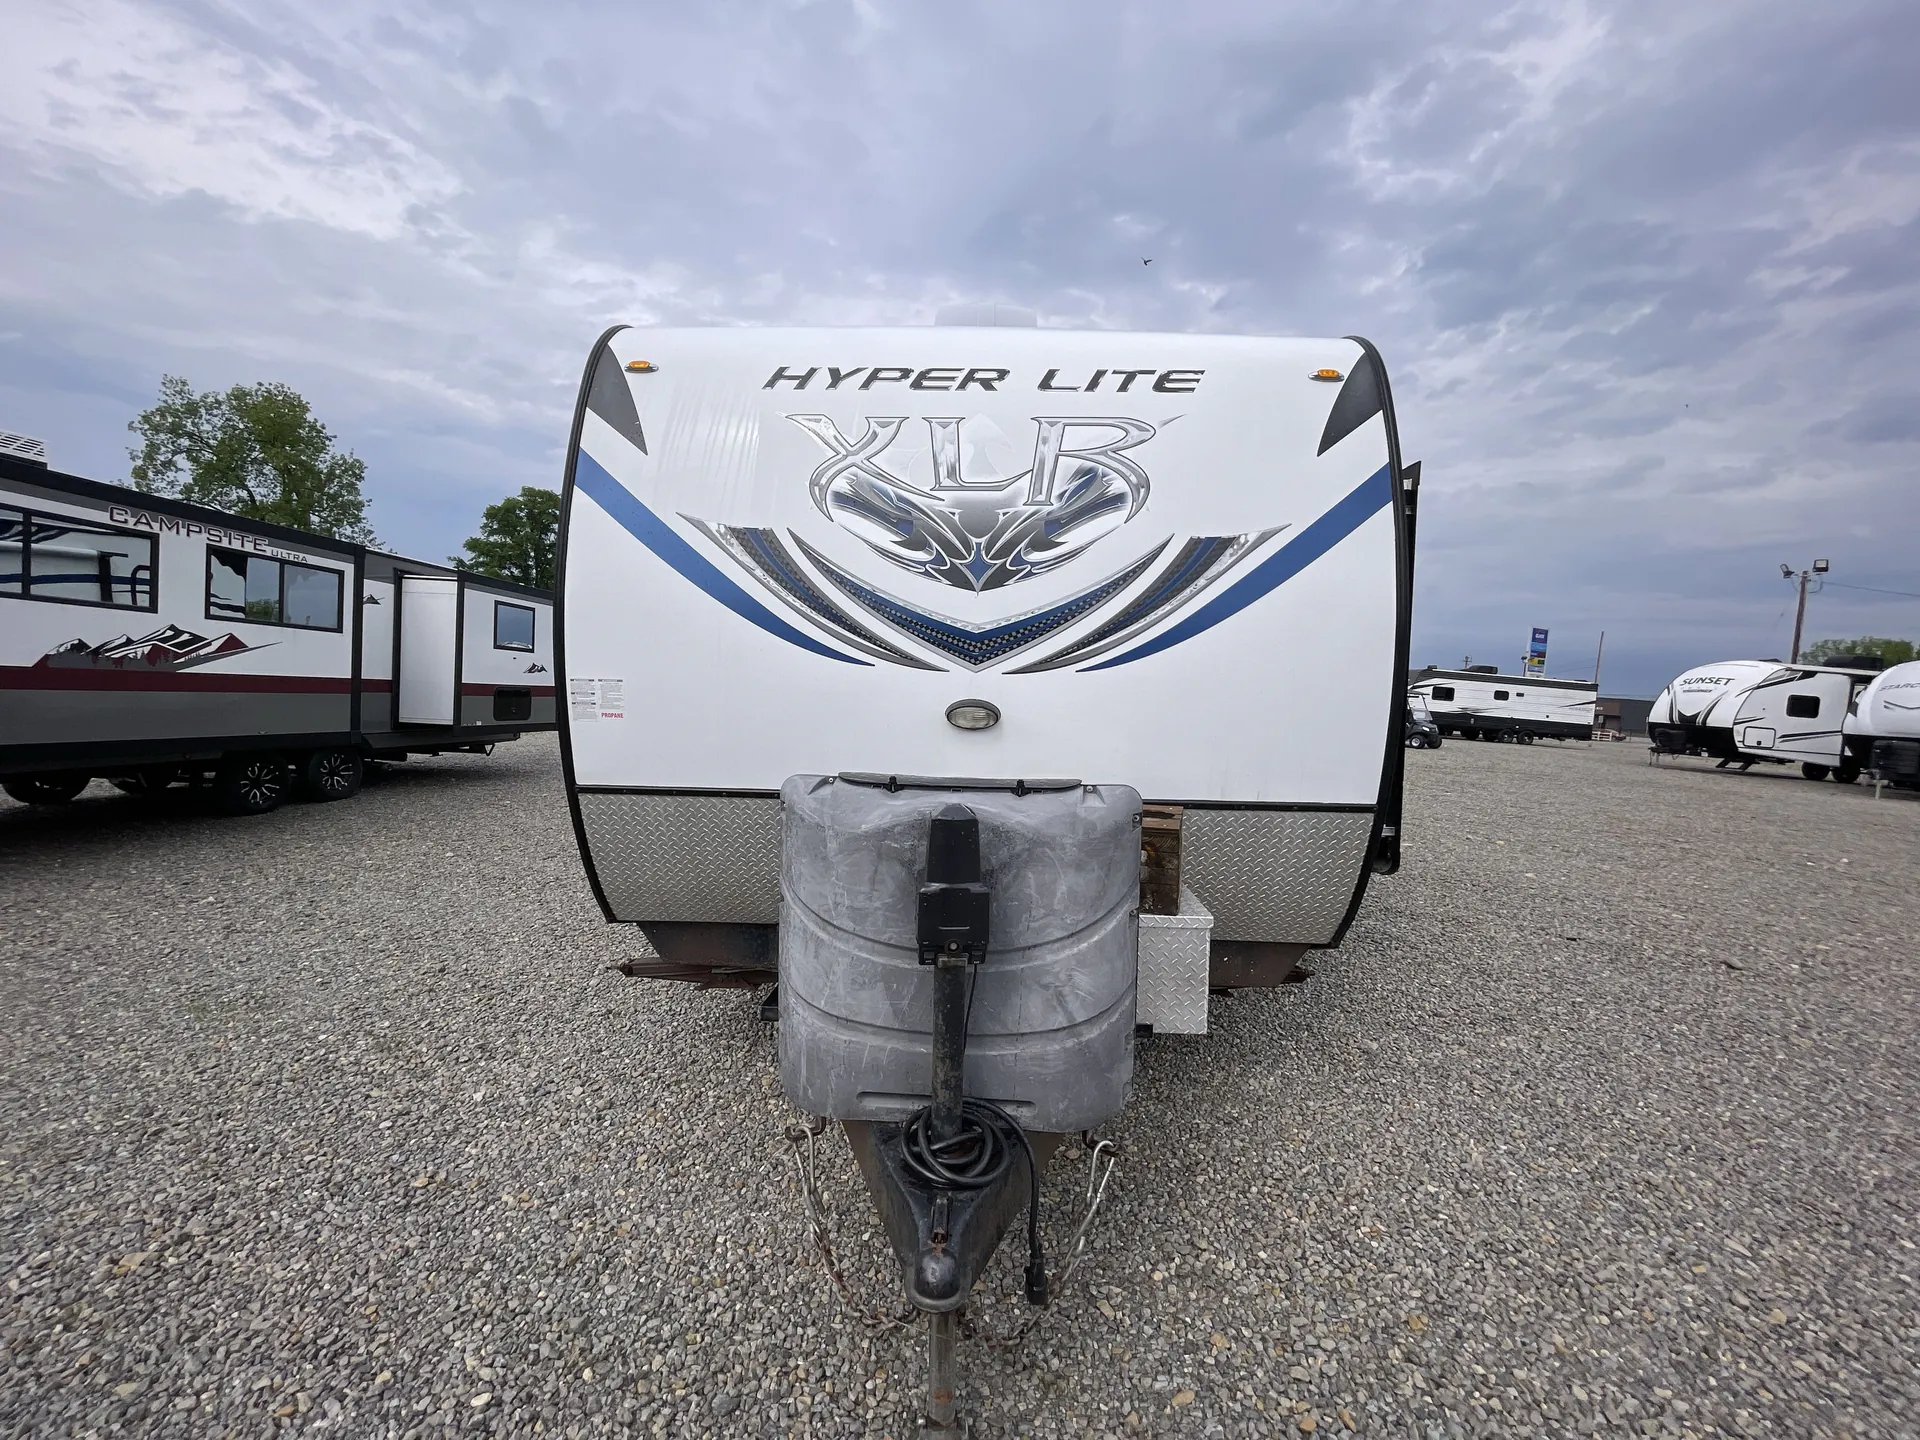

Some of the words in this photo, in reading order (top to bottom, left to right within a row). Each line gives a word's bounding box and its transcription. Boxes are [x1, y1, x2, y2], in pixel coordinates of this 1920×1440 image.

[761, 366, 1010, 392] HYPER
[1037, 368, 1206, 393] LITE
[778, 412, 1164, 524] XLR
[108, 506, 268, 553] CAMPSITE
[271, 548, 308, 563] ULTRA
[1679, 676, 1736, 686] SUNSET
